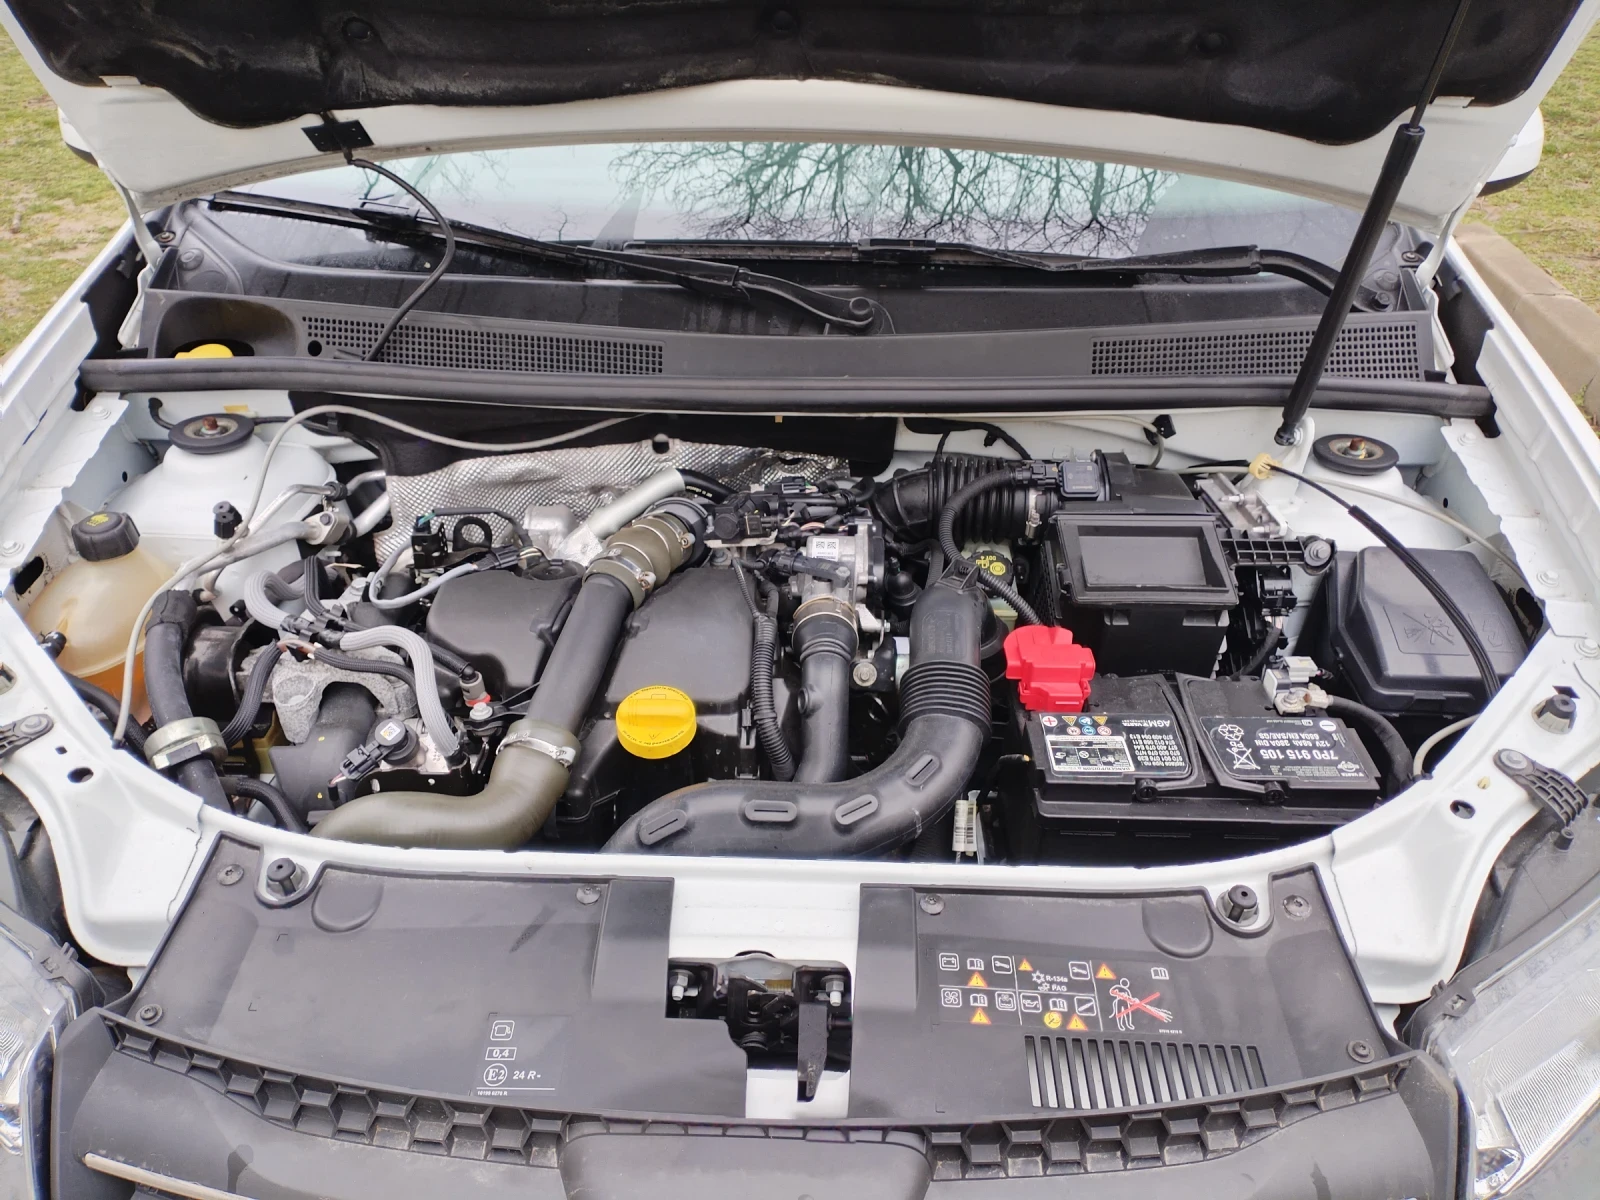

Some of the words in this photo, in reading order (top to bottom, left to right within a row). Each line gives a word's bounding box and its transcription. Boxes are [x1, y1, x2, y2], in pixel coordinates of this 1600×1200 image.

[1259, 749, 1284, 759] 105
[1286, 750, 1309, 759] 915
[1052, 983, 1067, 991] PAG
[493, 1049, 509, 1059] 0,4
[487, 1069, 505, 1081] E2
[513, 1071, 525, 1079] 24
